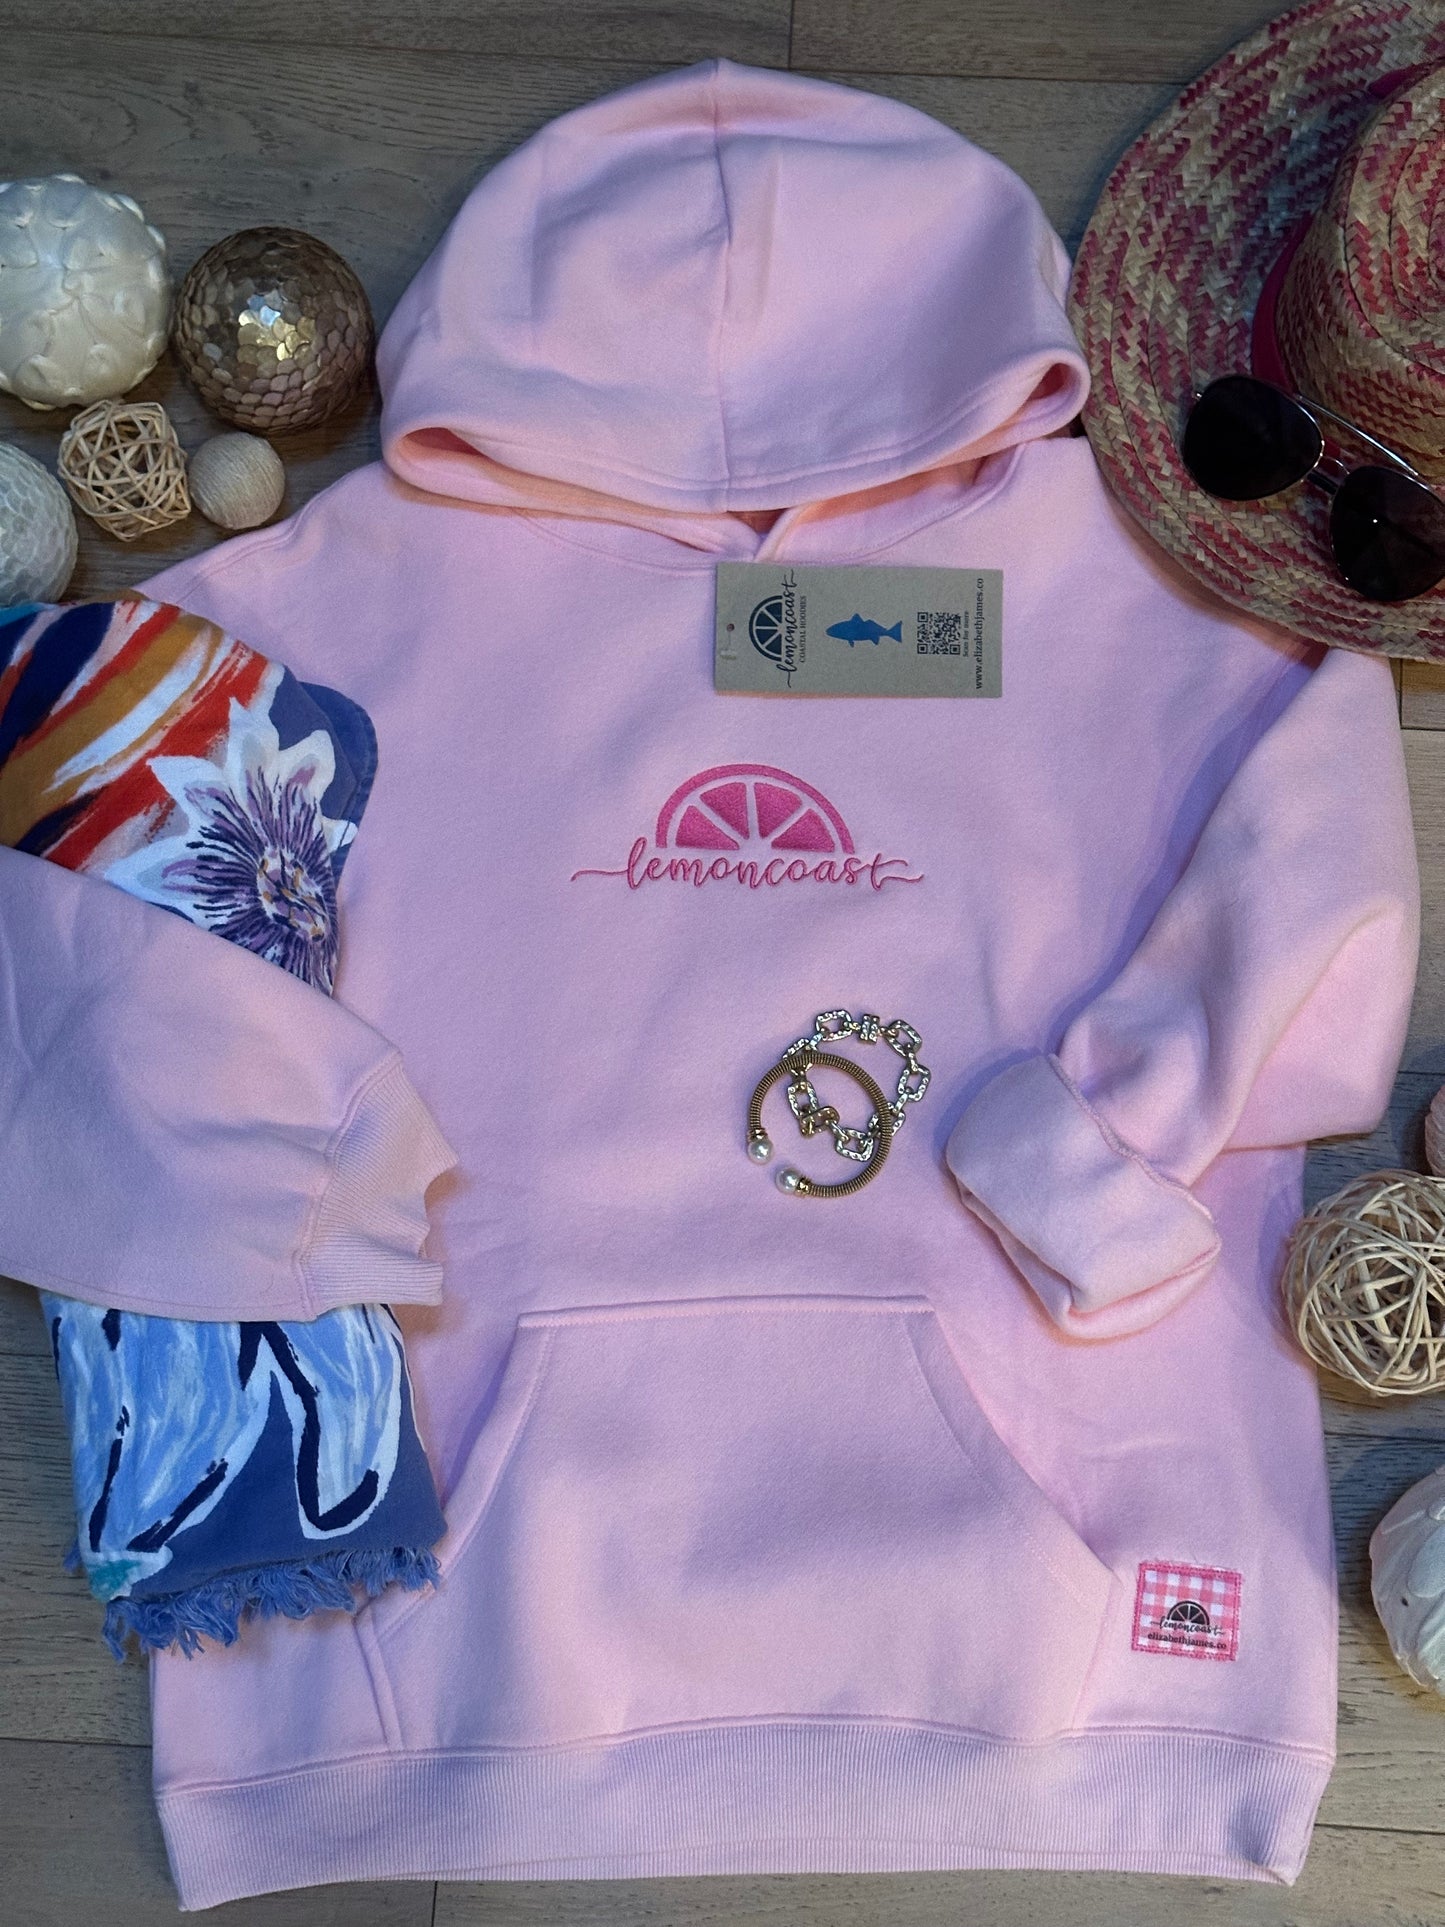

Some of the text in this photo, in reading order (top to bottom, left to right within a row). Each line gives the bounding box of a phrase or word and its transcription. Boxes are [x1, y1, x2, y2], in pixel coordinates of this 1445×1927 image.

[776, 569, 798, 688] lemoncoast
[799, 595, 807, 663] COASTAL HOODIES
[974, 578, 985, 689] www.elizabethjames.co
[571, 837, 924, 890] lemoncoast
[1147, 1632, 1227, 1650] elizabethjames.co
[1150, 1616, 1225, 1636] lemoncoast
